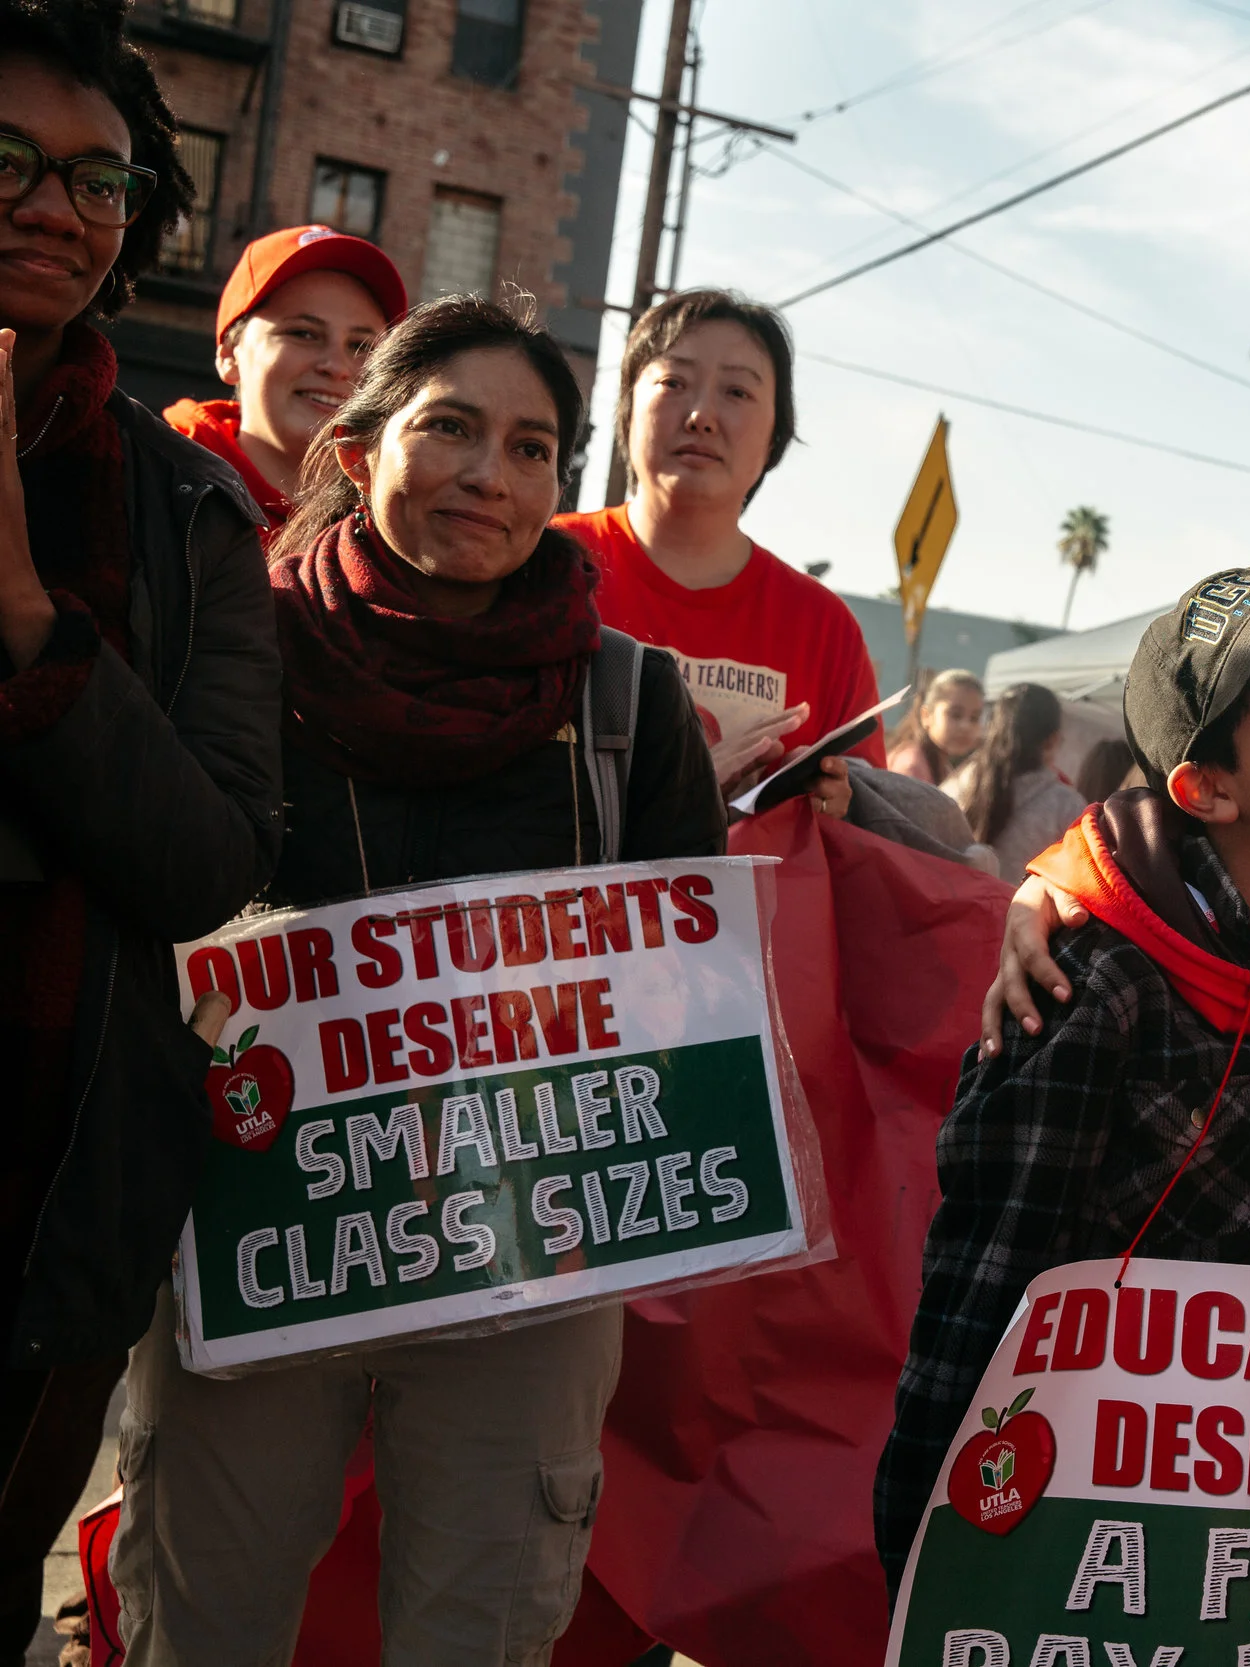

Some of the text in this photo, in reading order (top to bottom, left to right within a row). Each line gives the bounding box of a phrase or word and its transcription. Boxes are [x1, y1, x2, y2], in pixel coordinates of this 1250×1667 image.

[698, 664, 779, 703] TEACHERS!
[186, 875, 719, 1018] OUR STUDENTS
[318, 977, 621, 1095] DESERVE
[235, 1110, 273, 1135] UTLA
[295, 1065, 669, 1200] SMALLER
[236, 1145, 750, 1309] CLASS SIZES
[979, 1487, 1021, 1511] UTLA
[981, 1504, 1023, 1522] LOS ANGELES
[1065, 1519, 1146, 1615] A
